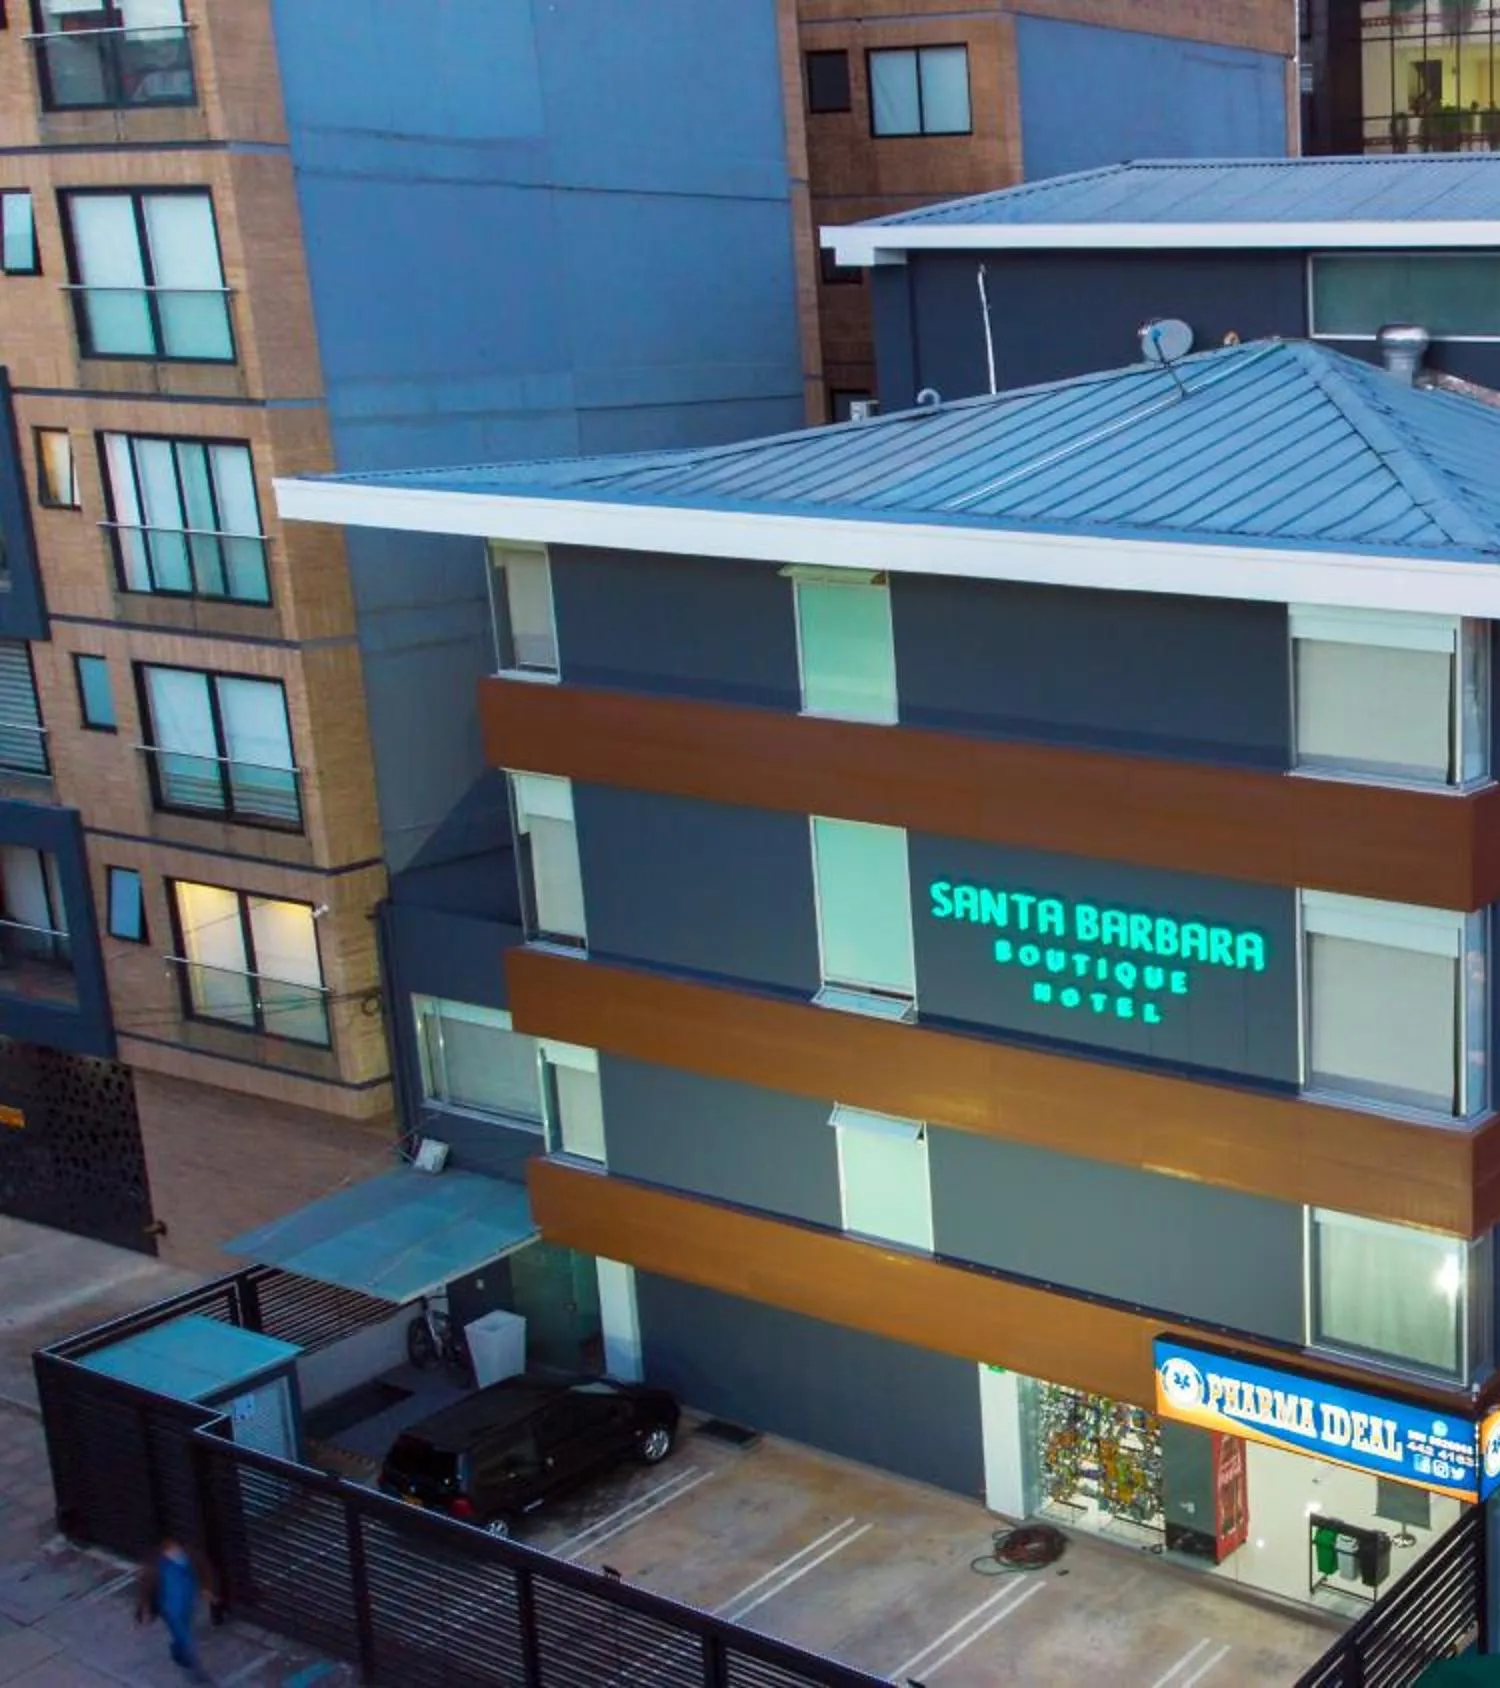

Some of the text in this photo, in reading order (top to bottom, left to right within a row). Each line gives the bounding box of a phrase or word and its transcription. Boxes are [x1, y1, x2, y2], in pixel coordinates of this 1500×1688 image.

[931, 882, 1265, 971] SANTA BARBARA
[995, 940, 1187, 994] BOUTIQUE
[1033, 982, 1160, 1023] HOTEL
[1206, 1373, 1317, 1439] PHARMA
[1320, 1403, 1403, 1462] IDEAL
